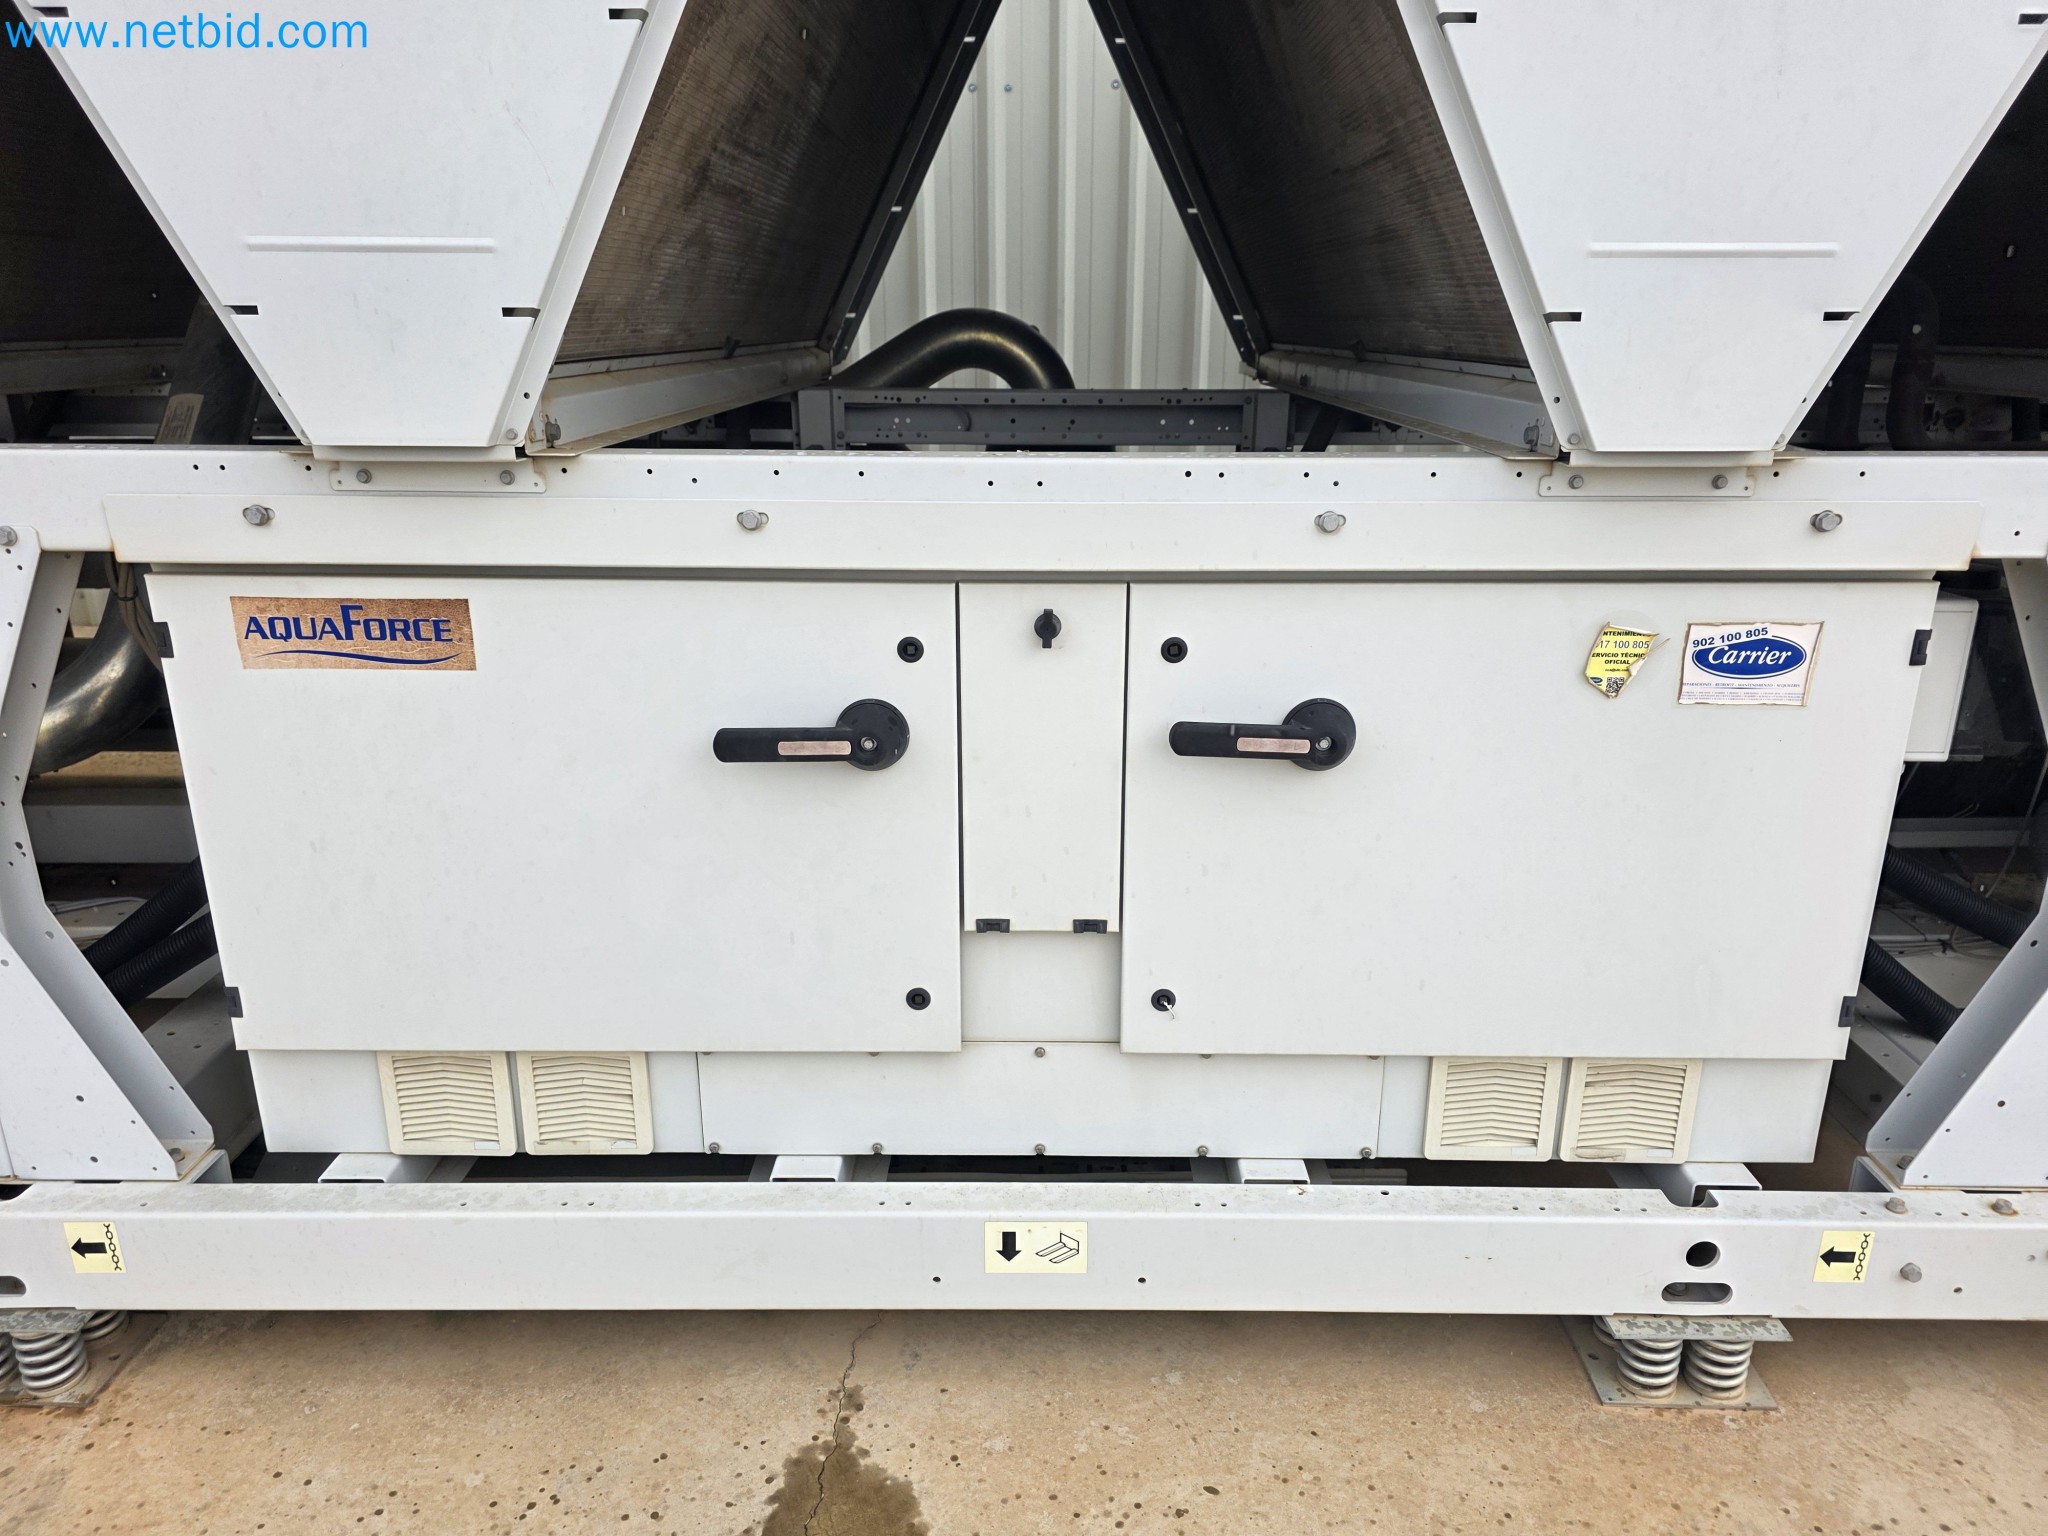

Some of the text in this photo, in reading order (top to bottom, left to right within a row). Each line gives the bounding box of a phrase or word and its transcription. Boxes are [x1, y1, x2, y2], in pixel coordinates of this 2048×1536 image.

[244, 604, 453, 643] AQUAFORCE
[1613, 640, 1630, 649] 100
[1632, 640, 1650, 649] 805
[1692, 627, 1768, 648] 902 100 805
[1708, 645, 1792, 665] Carrier
